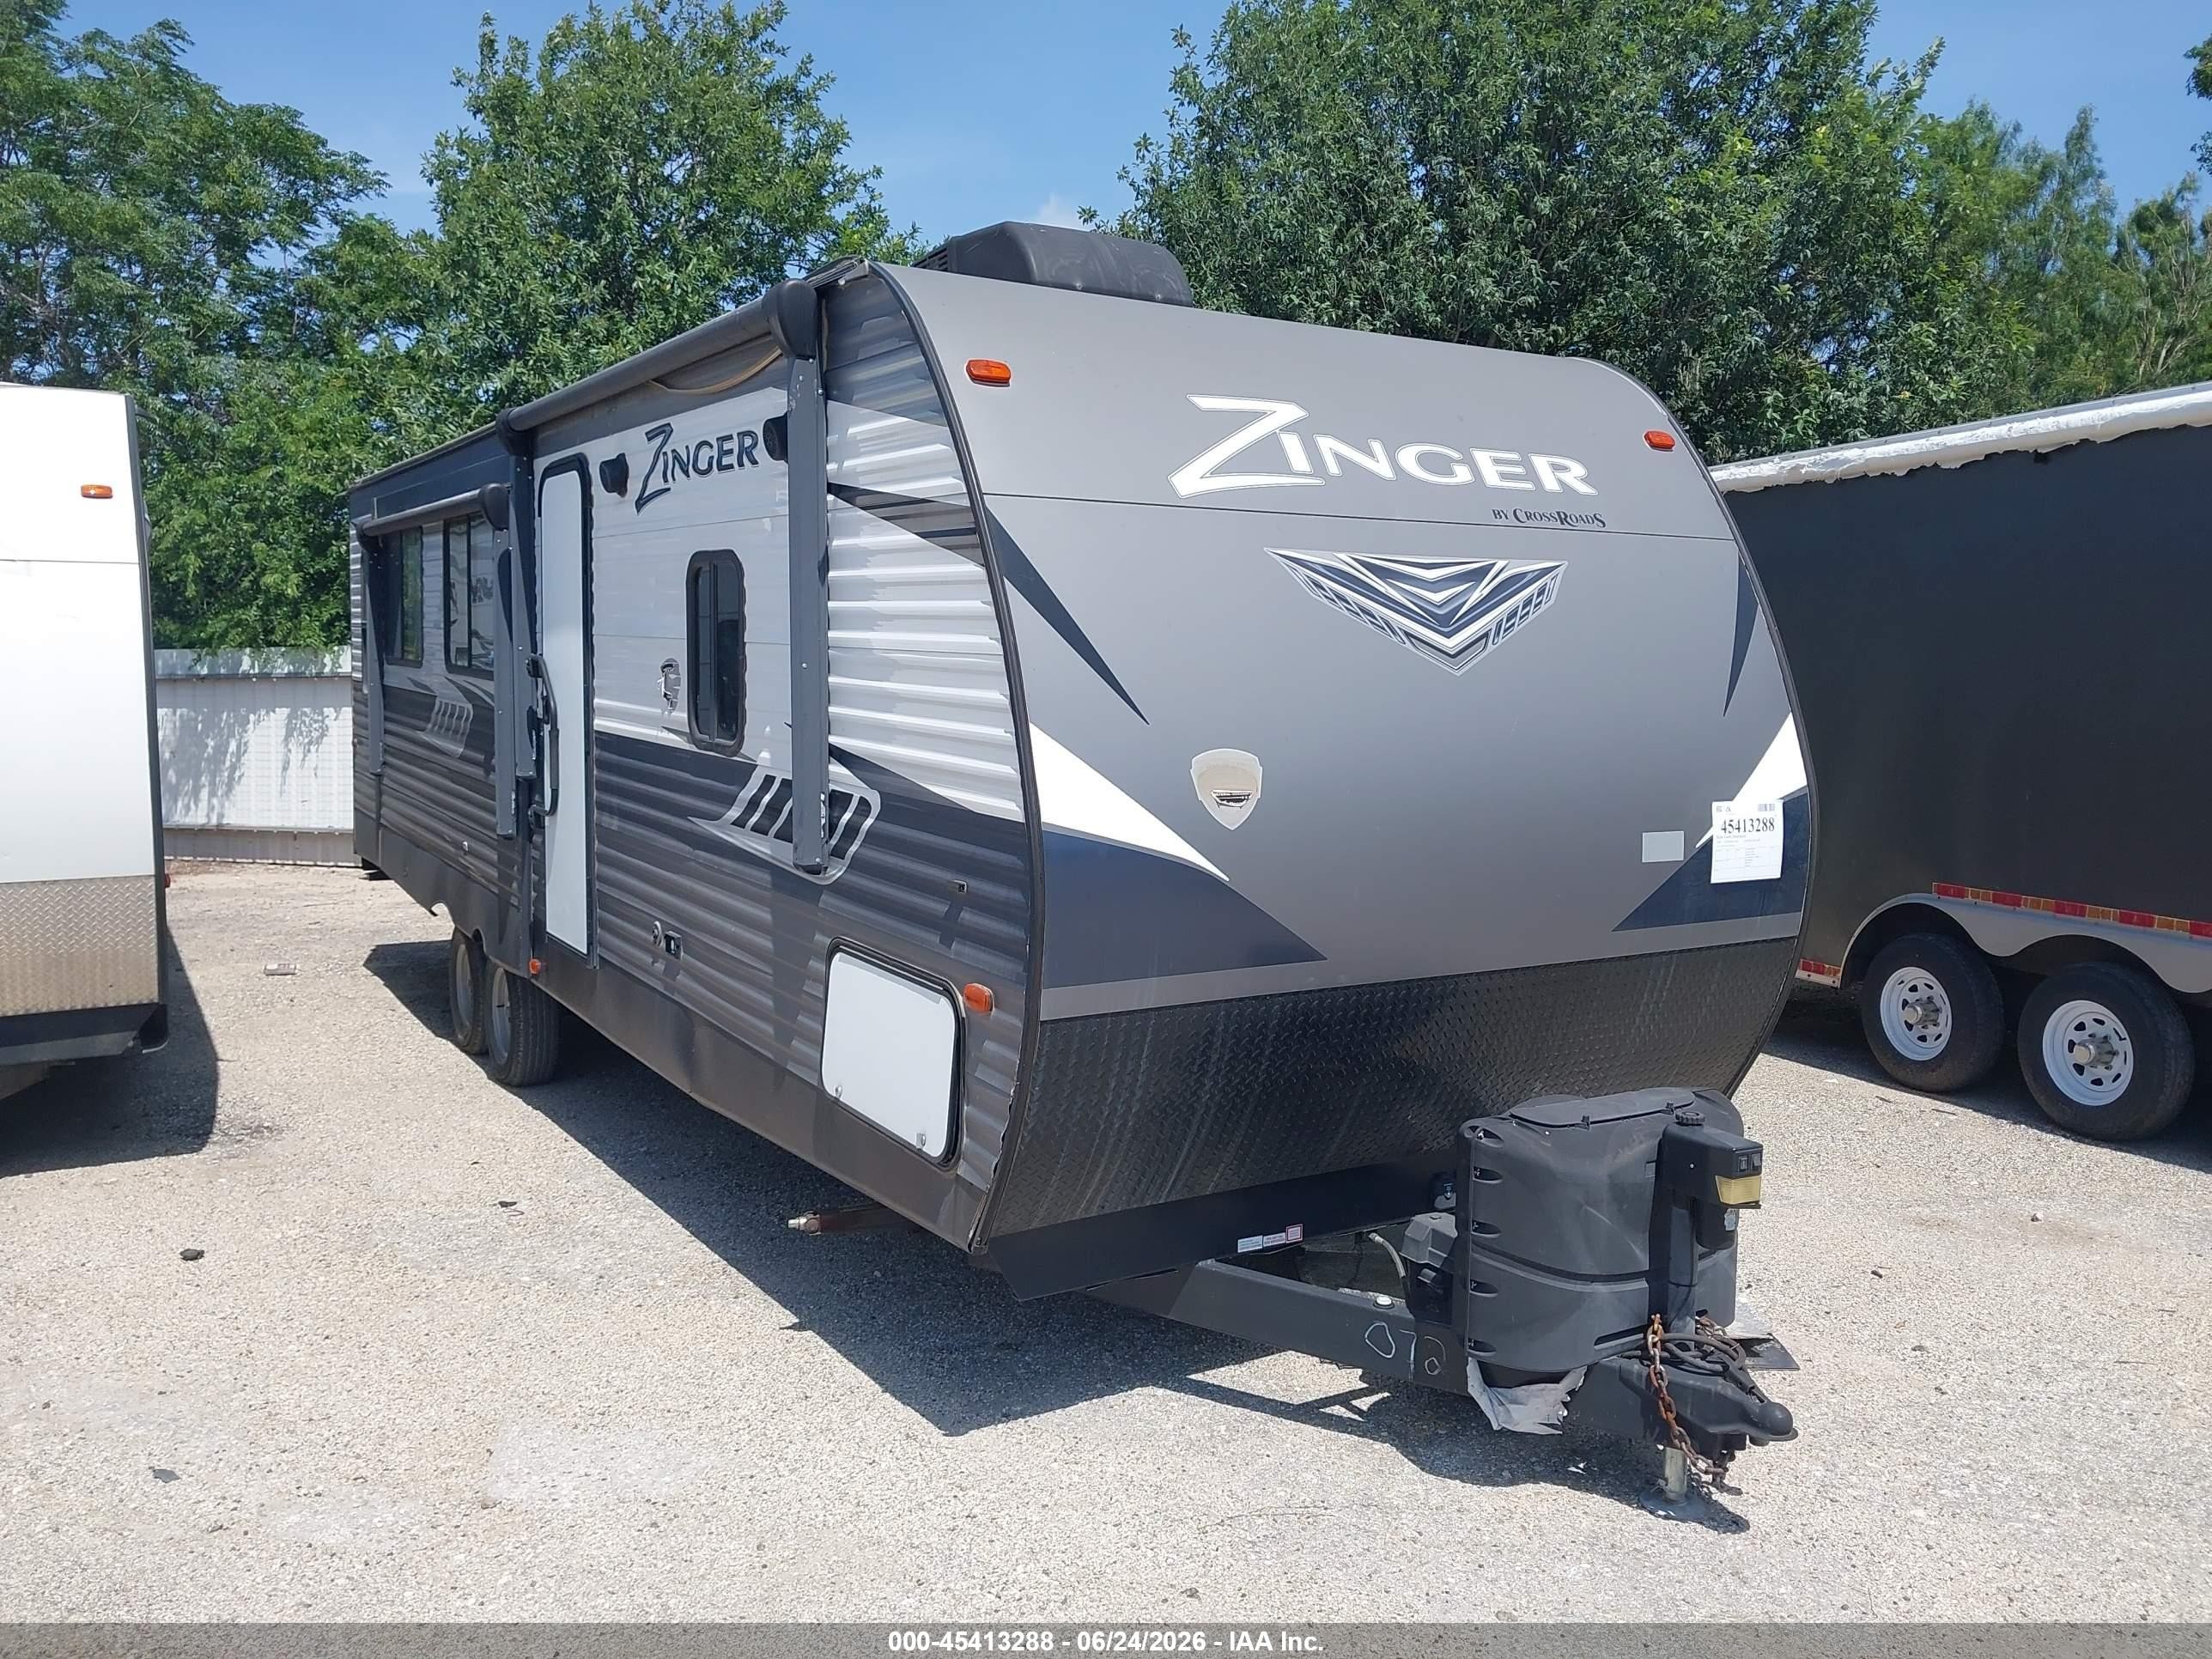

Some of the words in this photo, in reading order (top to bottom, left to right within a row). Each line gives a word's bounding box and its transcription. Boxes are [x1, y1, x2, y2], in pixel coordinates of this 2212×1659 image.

[635, 422, 760, 515] ZINGER
[1168, 394, 1598, 498] ZINGER
[1492, 508, 1509, 520] BY
[1721, 817, 1775, 834] 45413288
